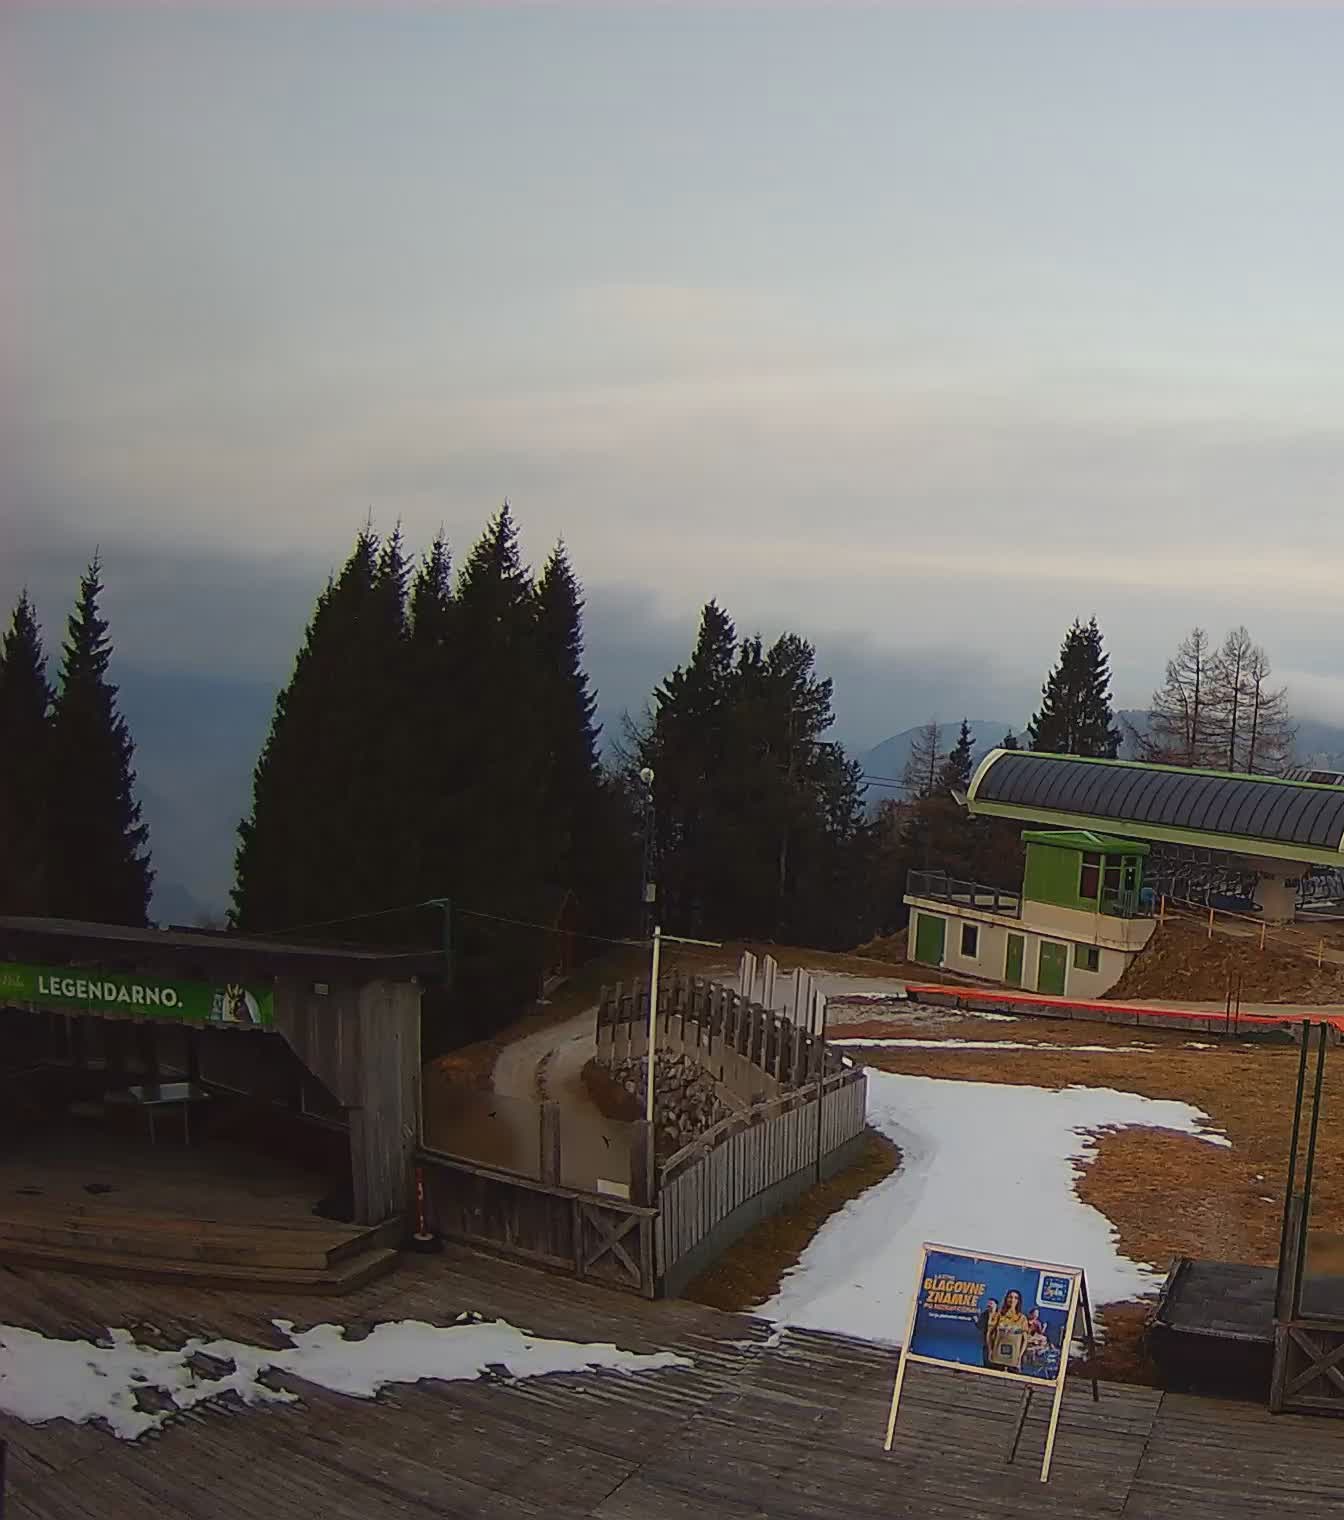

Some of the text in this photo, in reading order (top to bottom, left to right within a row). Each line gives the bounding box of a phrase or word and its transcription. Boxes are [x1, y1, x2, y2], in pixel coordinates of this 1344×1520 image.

[38, 975, 184, 1008] LEGENDARNO.
[924, 1278, 986, 1295] BLAGOVNE
[926, 1291, 979, 1306] ZNAMKE
